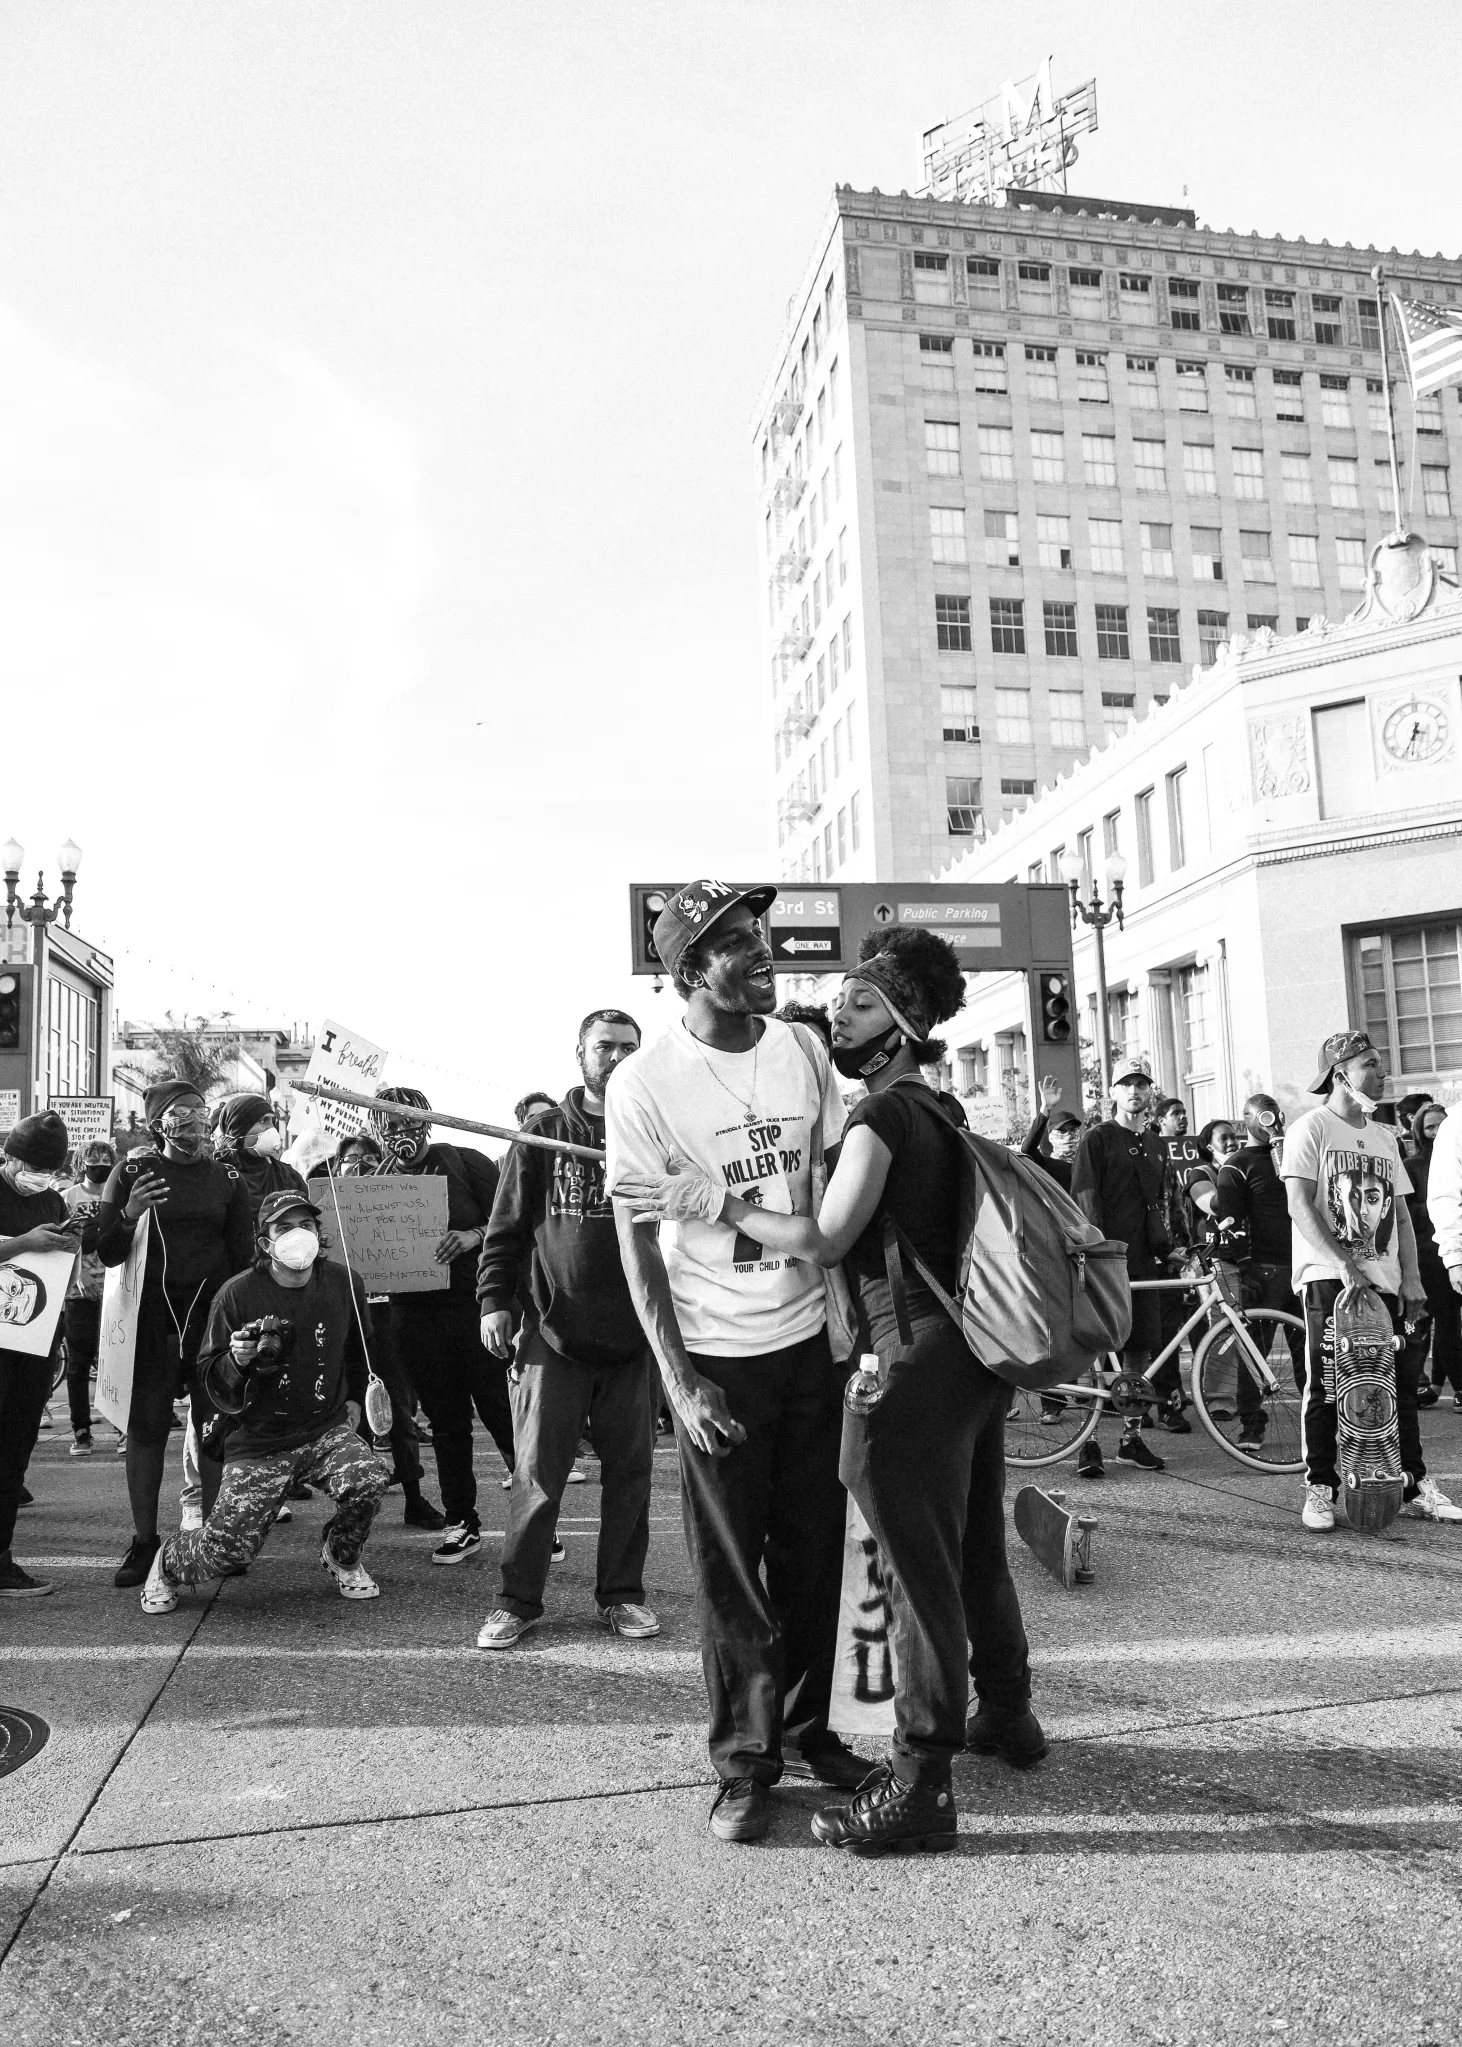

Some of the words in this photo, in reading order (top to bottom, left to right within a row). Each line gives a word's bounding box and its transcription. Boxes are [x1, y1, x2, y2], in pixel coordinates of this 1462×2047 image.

[774, 900, 804, 915] 3rd
[814, 900, 835, 915] St
[903, 907, 938, 919] Public
[945, 907, 989, 921] Parking
[794, 941, 811, 949] ONE
[813, 941, 829, 949] WAY
[337, 1041, 379, 1078] breathe
[715, 1124, 742, 1137] STRUGGLE
[743, 1119, 763, 1129] AGAINST
[721, 1152, 779, 1188] KILLER
[778, 1148, 802, 1173] OPS
[1326, 1150, 1360, 1180] KOBE
[1374, 1155, 1395, 1181] GIG
[354, 1183, 394, 1194] SYSTEM
[349, 1215, 371, 1224] NOT
[375, 1215, 397, 1225] FOR
[372, 1228, 407, 1242] ALL
[734, 1263, 754, 1274] YOUR
[759, 1260, 780, 1272] CHILD
